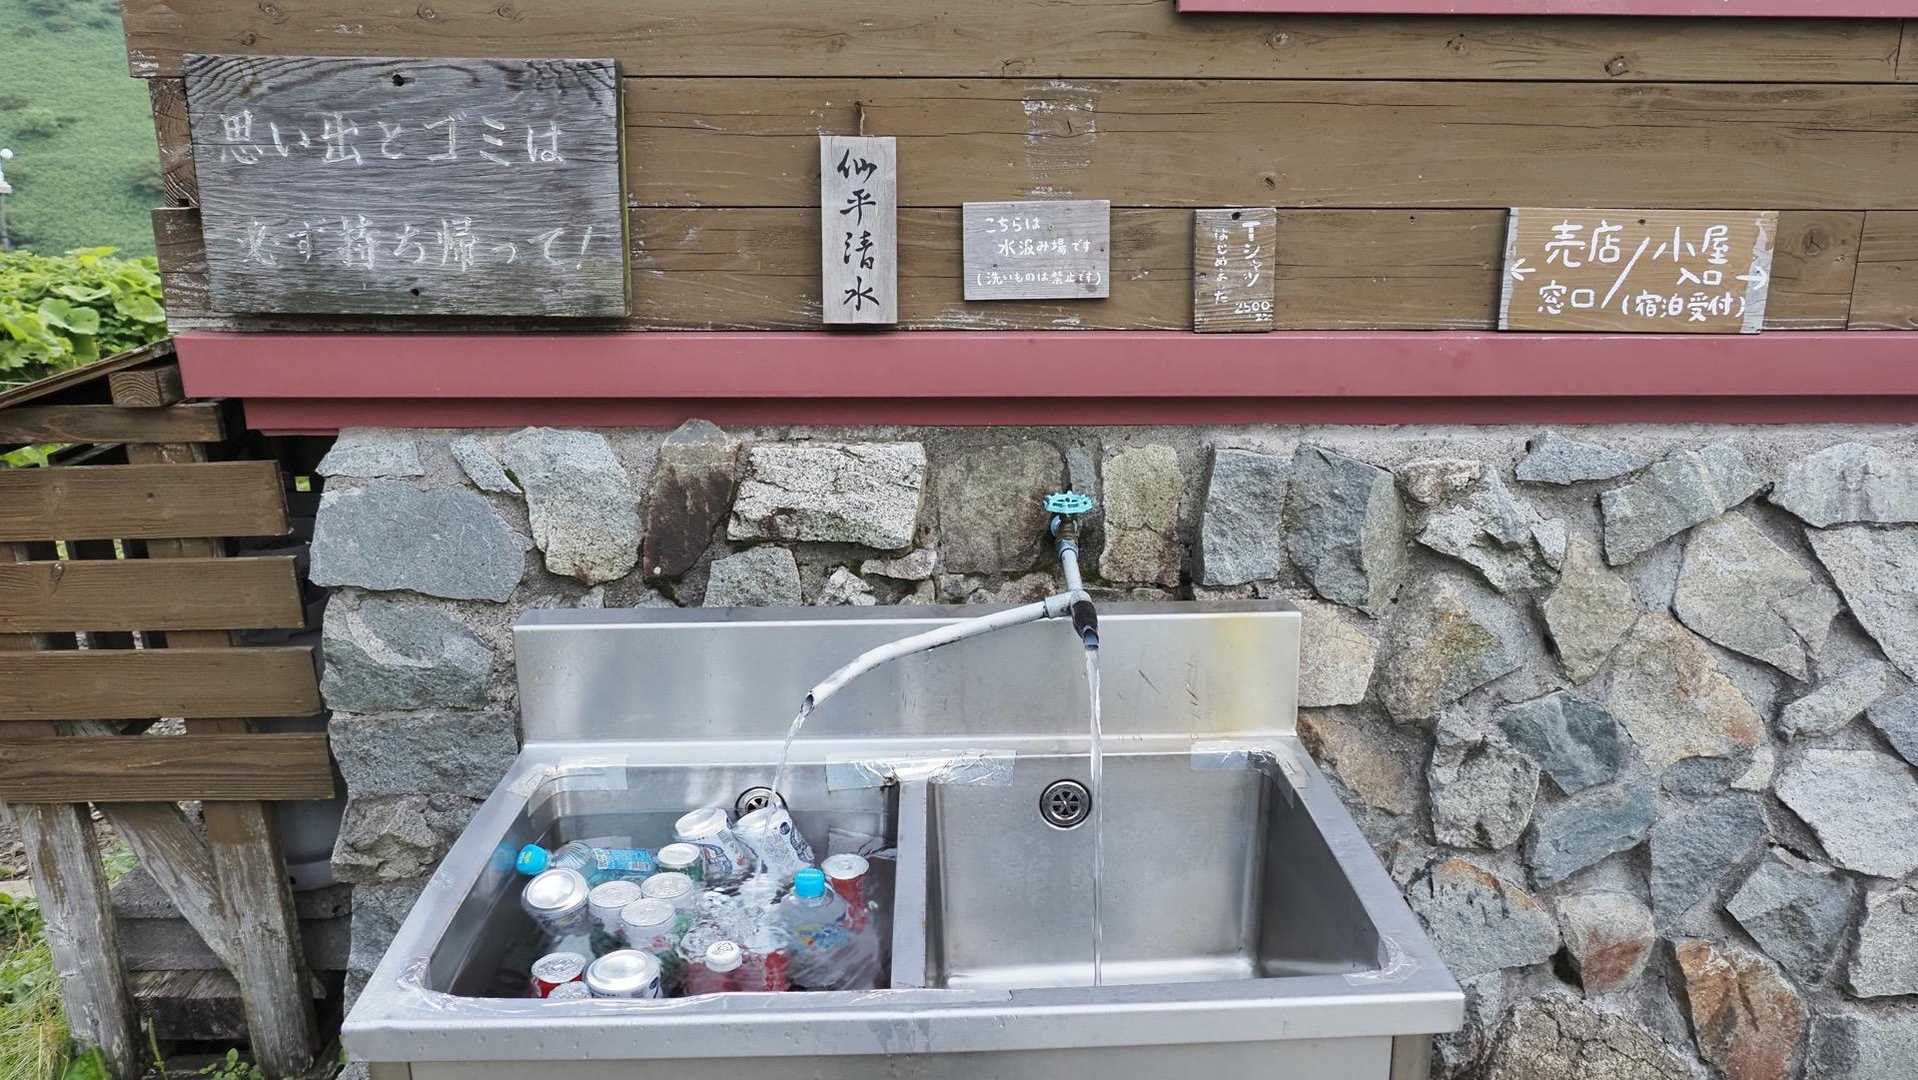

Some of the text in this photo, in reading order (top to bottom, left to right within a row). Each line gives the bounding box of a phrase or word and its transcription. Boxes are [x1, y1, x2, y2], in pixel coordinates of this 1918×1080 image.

[219, 109, 566, 166] 思い出とゴミは
[836, 148, 881, 312] 仙平清水
[984, 215, 1041, 234] こちらは
[998, 238, 1092, 256] 水汲み場です
[1544, 219, 1623, 268] 売店
[1652, 224, 1729, 265] 小屋
[1676, 266, 1723, 286] 入口
[1233, 300, 1271, 315] 2500
[1537, 280, 1595, 315] 窓口
[1621, 288, 1746, 322] (宿泊受付)
